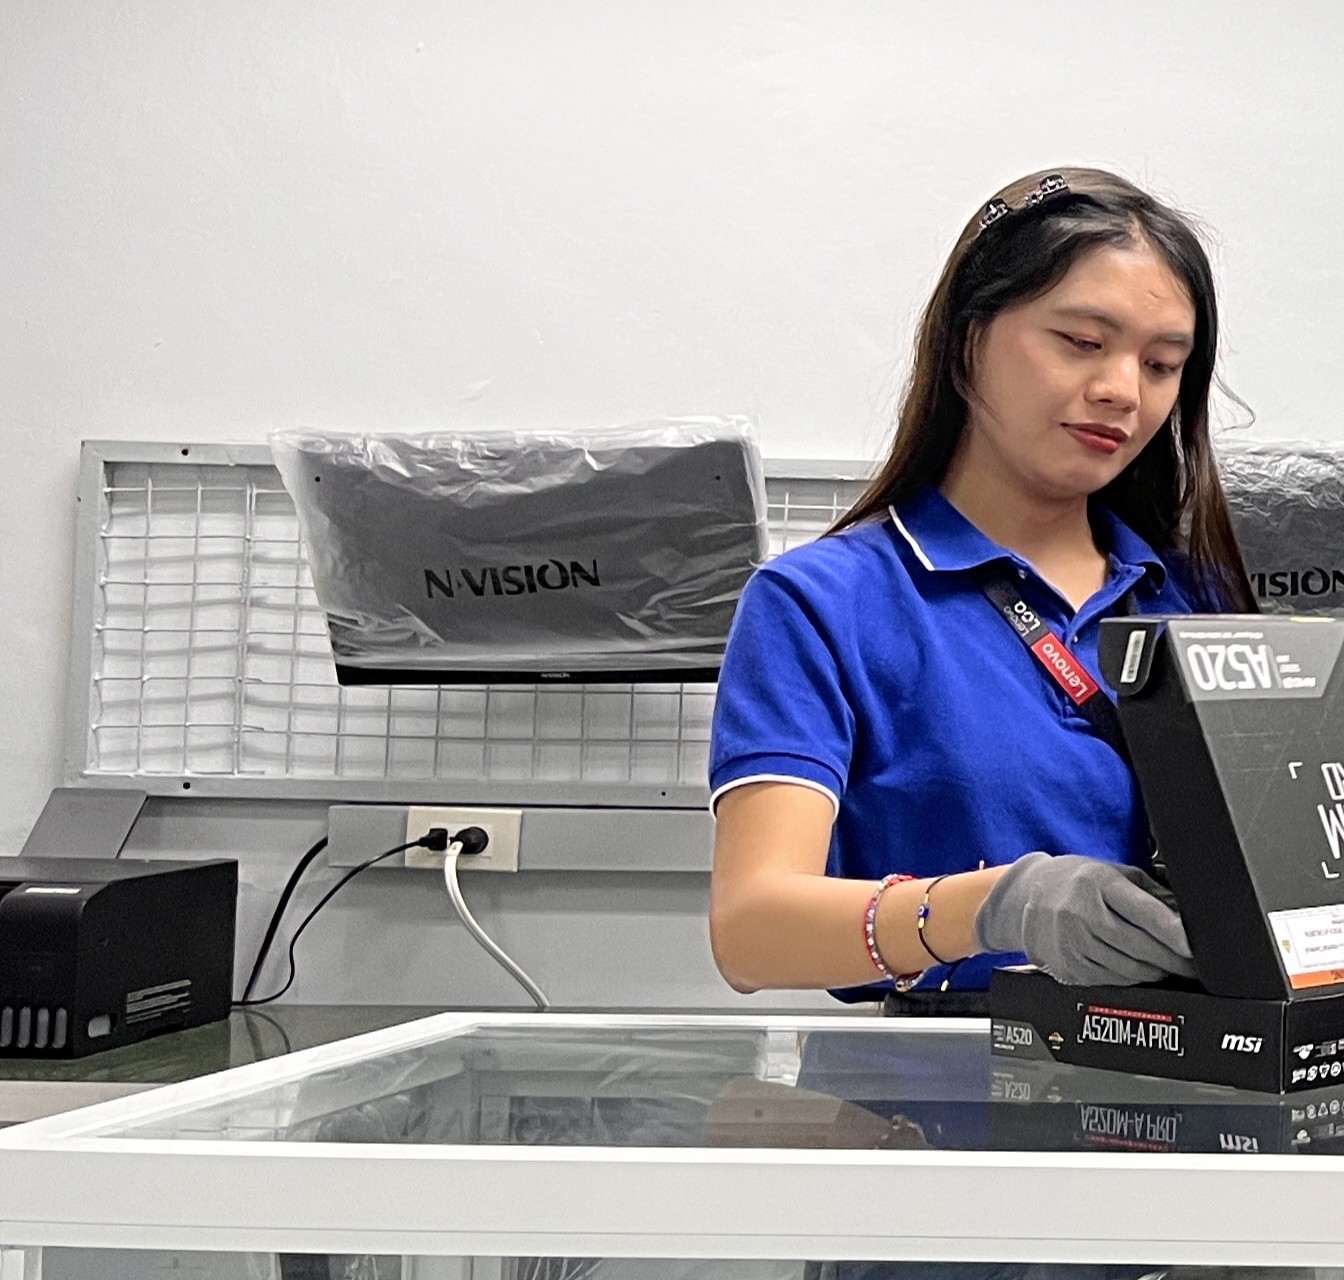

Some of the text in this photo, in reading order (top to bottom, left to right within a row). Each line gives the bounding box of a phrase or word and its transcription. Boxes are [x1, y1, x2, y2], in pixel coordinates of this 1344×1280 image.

[1014, 601, 1040, 631] LOQ
[1042, 643, 1088, 698] Lenovo
[1187, 644, 1272, 691] A520
[1006, 1025, 1033, 1046] A520
[1082, 1014, 1147, 1048] A520M-A
[1148, 1024, 1180, 1052] PRO
[1221, 1034, 1263, 1054] msi
